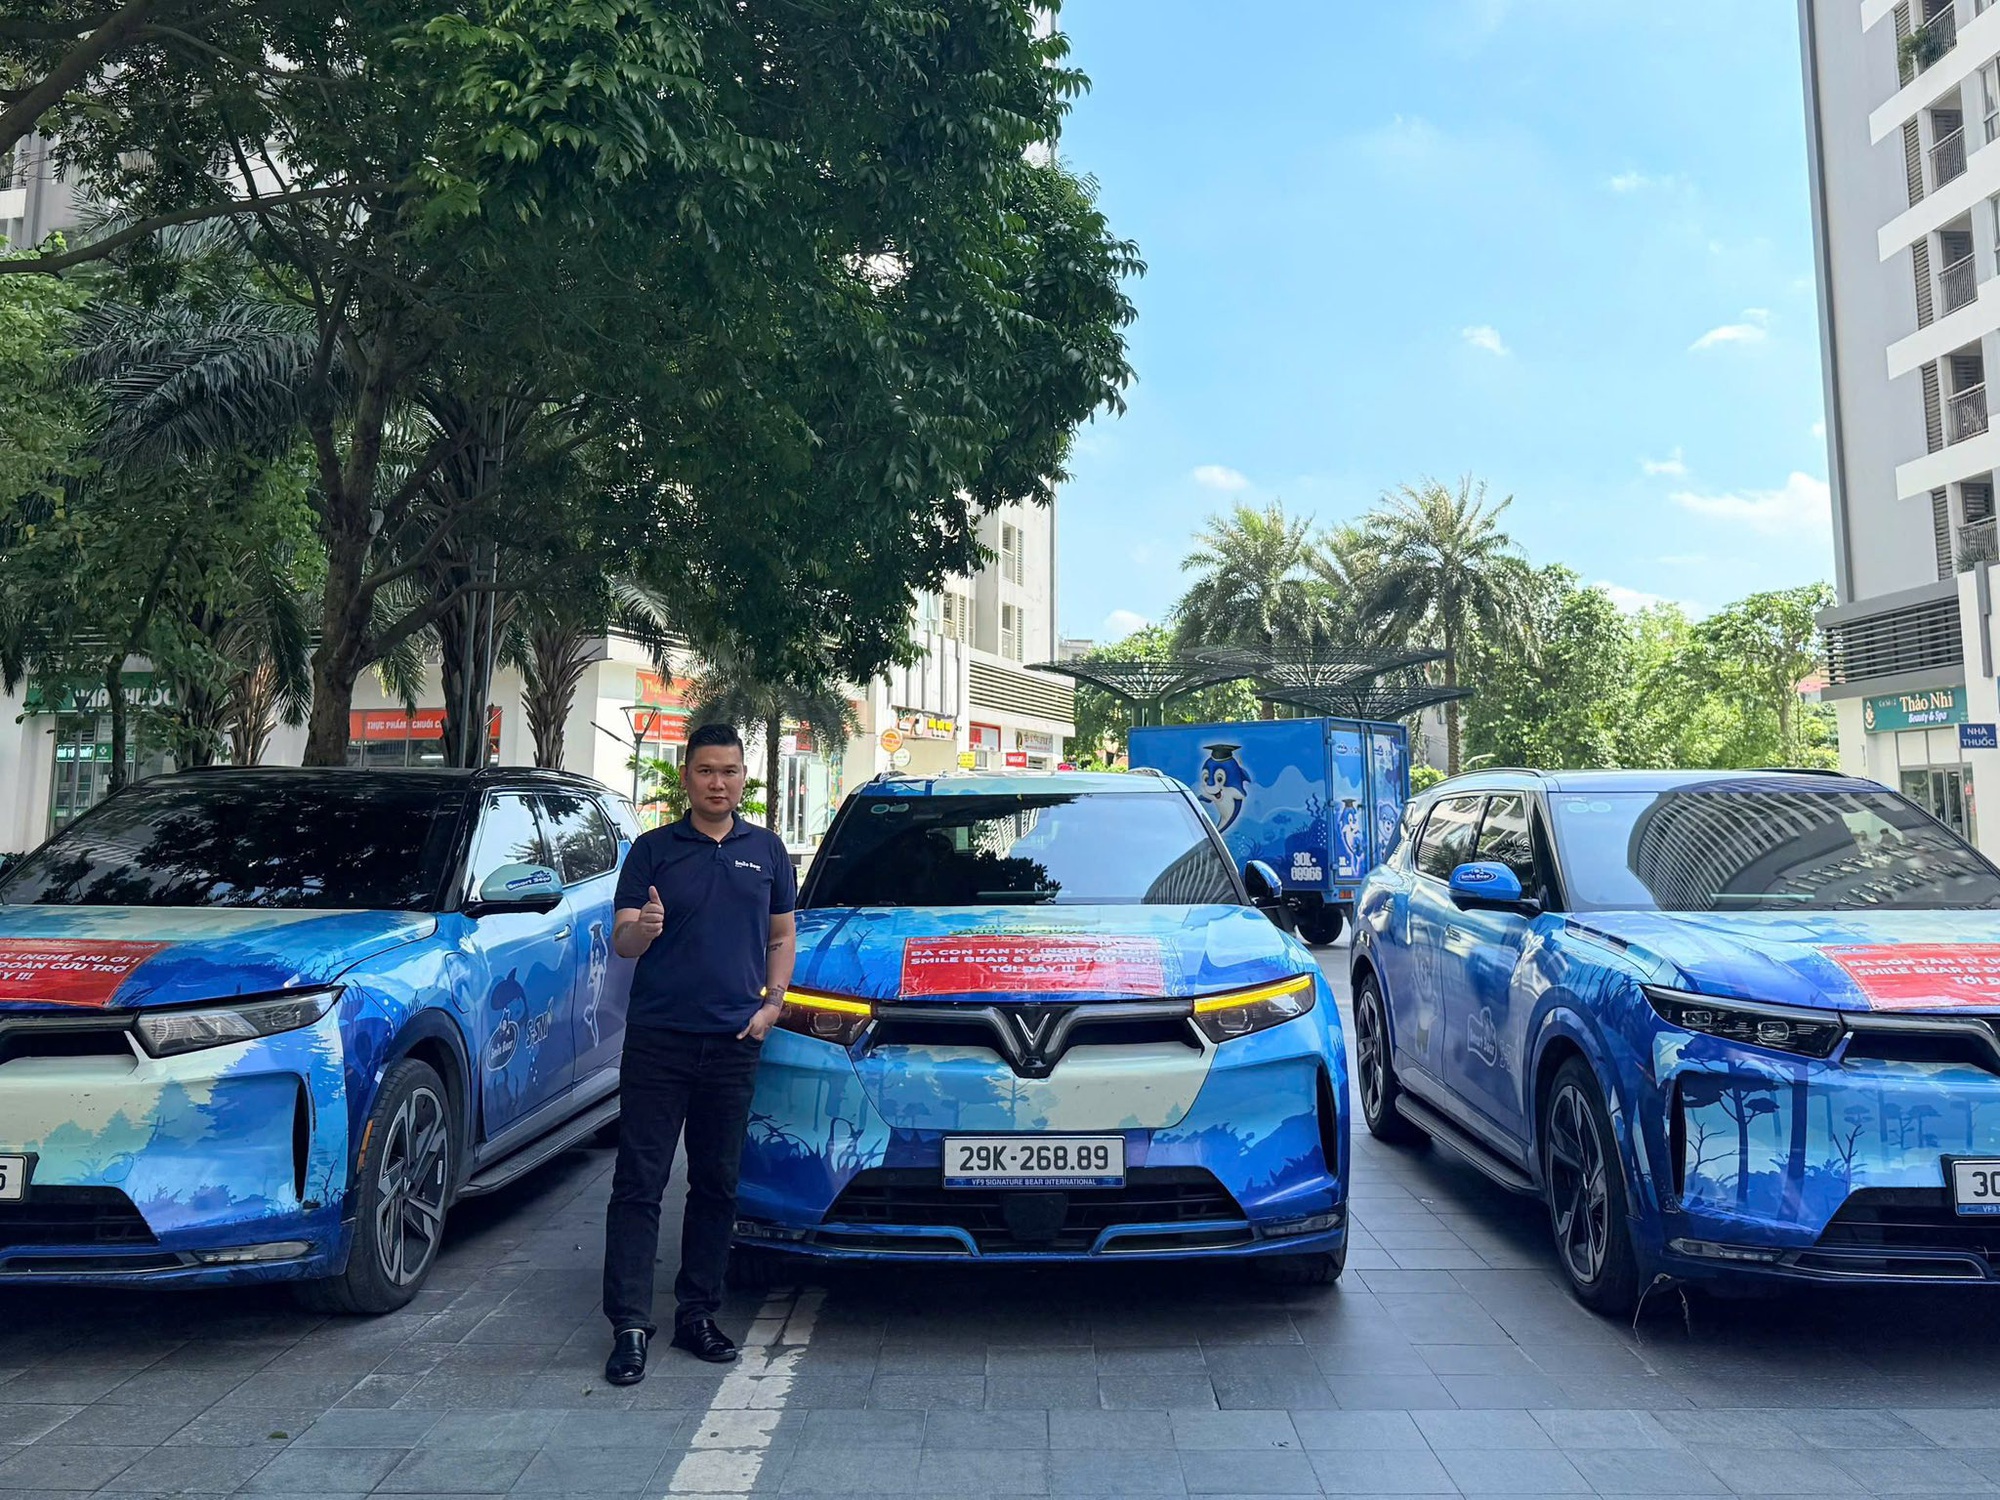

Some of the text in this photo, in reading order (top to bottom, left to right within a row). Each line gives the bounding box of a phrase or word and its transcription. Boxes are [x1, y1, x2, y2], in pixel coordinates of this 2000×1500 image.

[1899, 691, 1953, 712] Thảo Nhi
[1908, 712, 1929, 724] Beauty
[1935, 710, 1947, 722] Spa
[1967, 727, 1988, 735] NHÀ
[1962, 737, 1995, 746] THUỐC
[16, 952, 72, 963] (NGHỆ
[73, 955, 106, 963] AN)
[911, 957, 959, 965] SMILE
[91, 964, 130, 974] TRỢ
[1856, 967, 1911, 976] SMILE
[1914, 966, 1964, 974] BEAR
[1966, 966, 1980, 974] &
[15, 972, 35, 981] !!!
[1953, 975, 1984, 985] TỚI
[959, 1145, 1109, 1171] 29K-268.89
